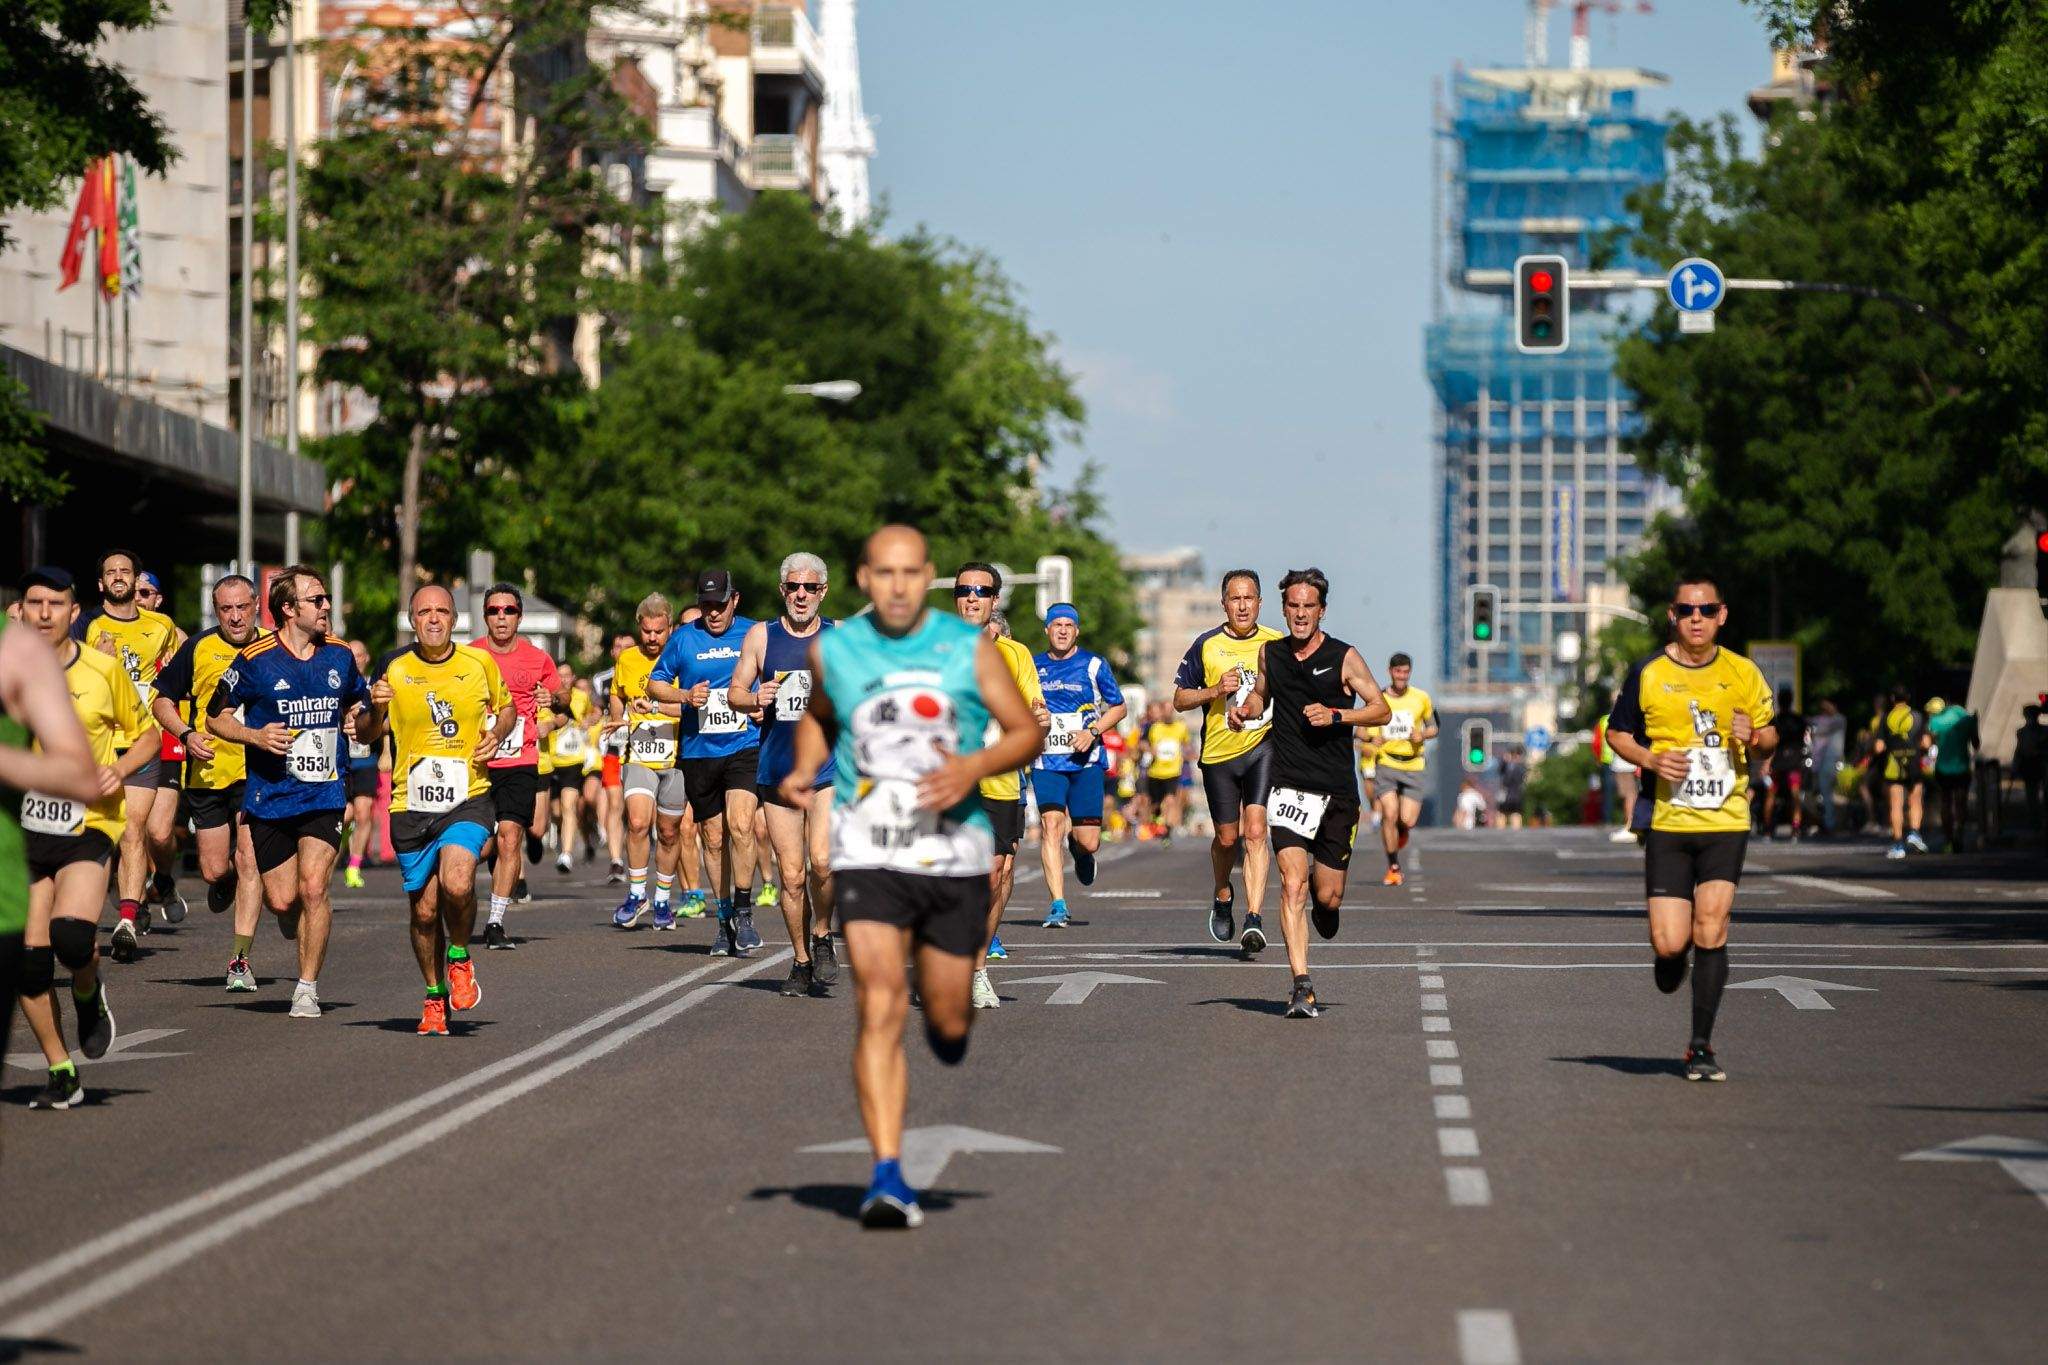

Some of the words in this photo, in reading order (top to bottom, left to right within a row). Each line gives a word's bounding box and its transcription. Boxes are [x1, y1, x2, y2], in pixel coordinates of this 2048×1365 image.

[277, 696, 340, 715] Emirates
[289, 714, 303, 727] FLY
[304, 711, 333, 725] BETTER
[709, 711, 738, 725] 1654
[443, 723, 456, 734] 13
[637, 741, 665, 754] 3878
[296, 756, 330, 772] 3534
[417, 785, 455, 803] 1634
[1685, 779, 1724, 797] 4341
[26, 798, 72, 822] 2398
[1276, 803, 1309, 826] 3071
